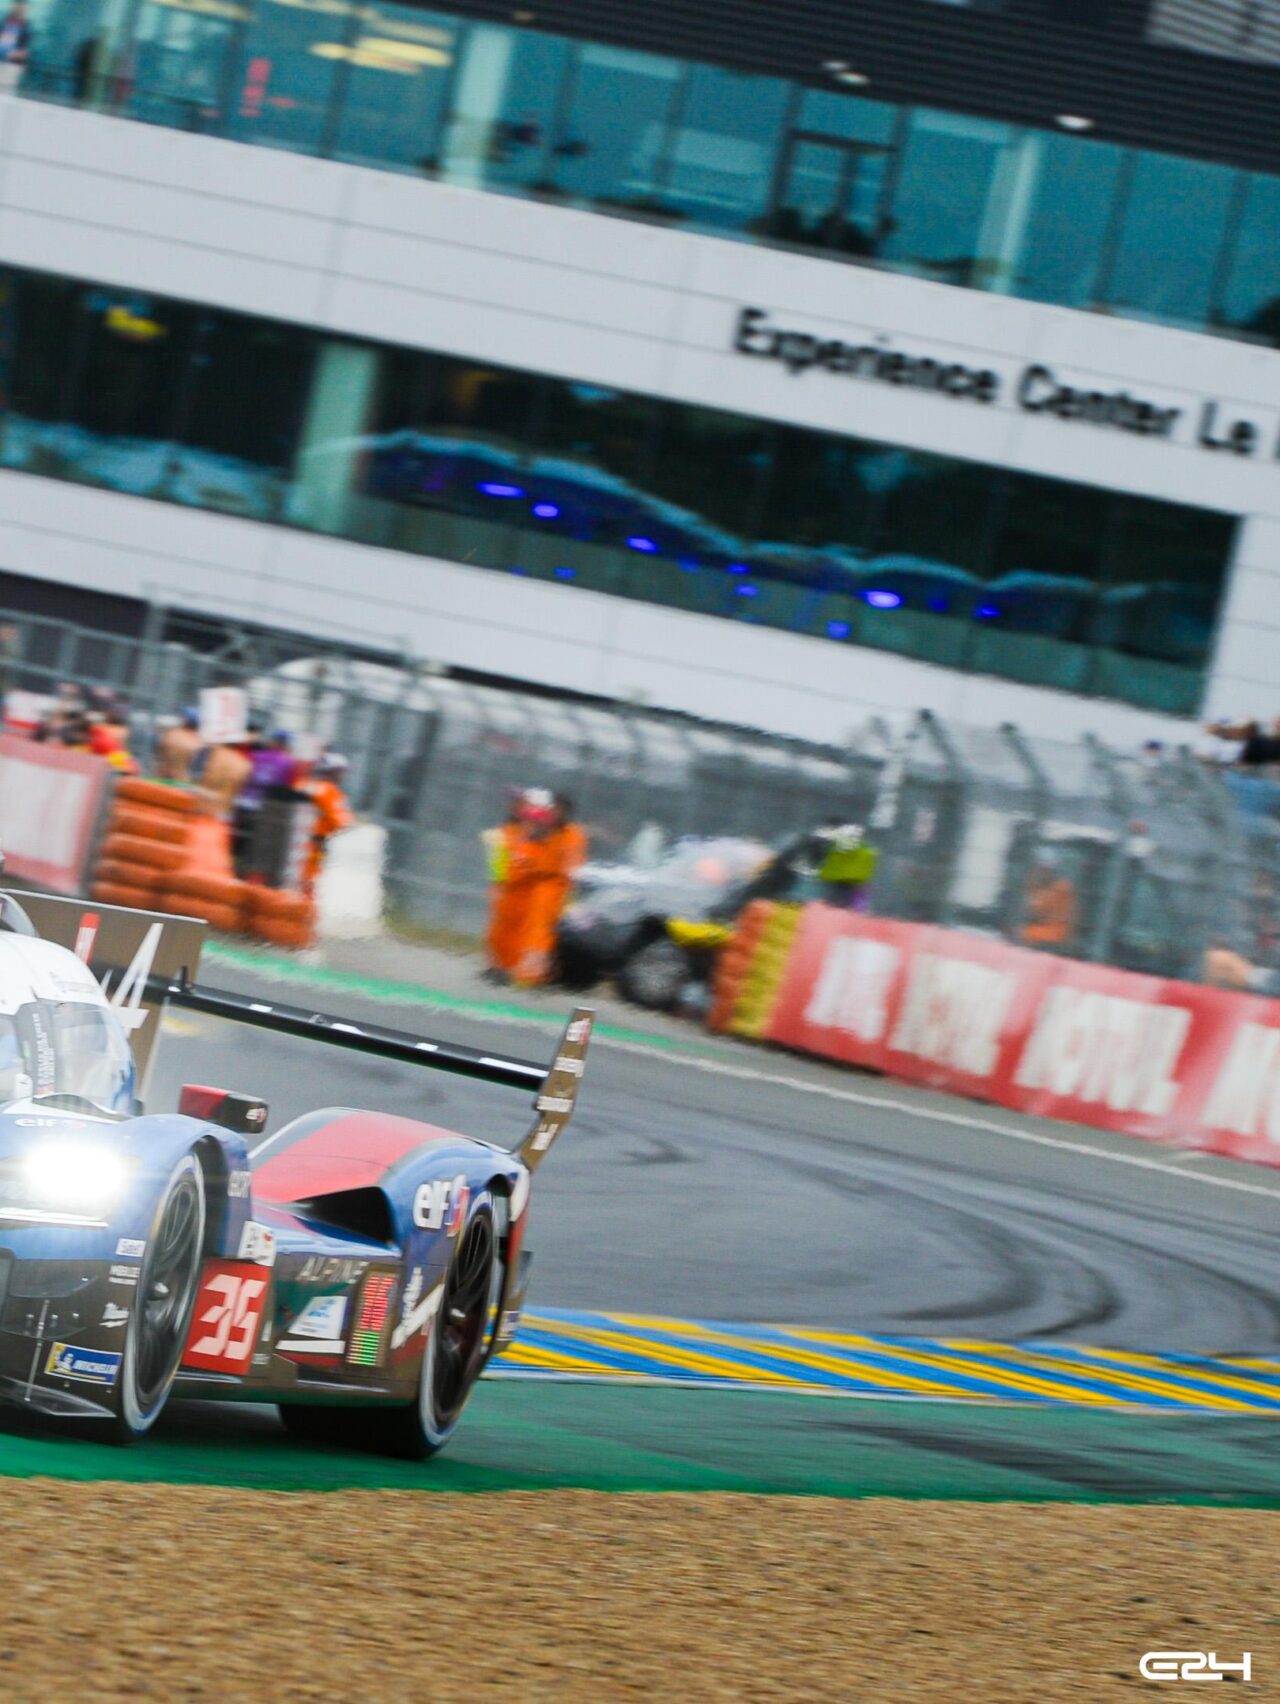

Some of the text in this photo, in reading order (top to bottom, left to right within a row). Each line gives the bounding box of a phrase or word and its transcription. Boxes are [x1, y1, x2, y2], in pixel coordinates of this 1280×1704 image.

[734, 306, 1000, 402] Experience
[1017, 363, 1182, 436] Center
[1200, 402, 1257, 455] Le
[413, 1180, 453, 1229] elf
[190, 1273, 267, 1361] 35
